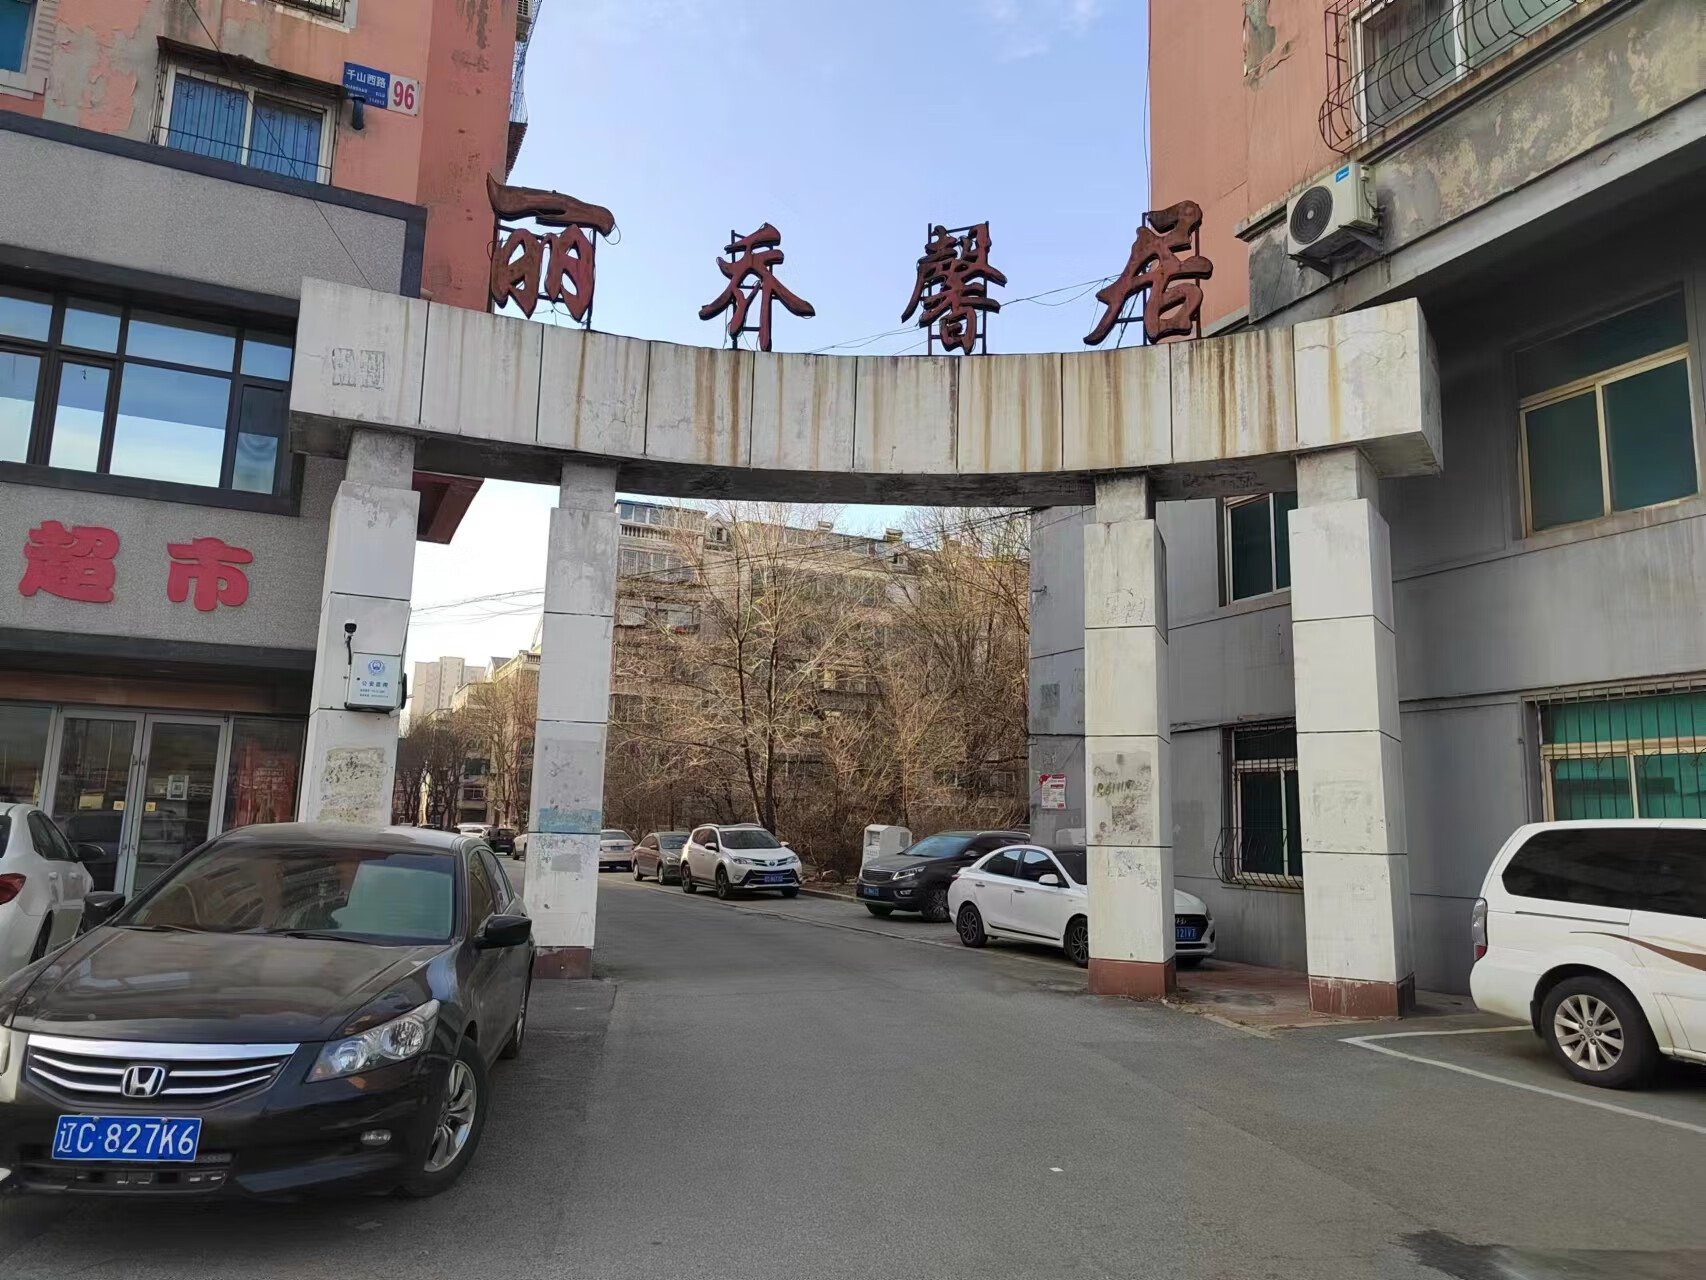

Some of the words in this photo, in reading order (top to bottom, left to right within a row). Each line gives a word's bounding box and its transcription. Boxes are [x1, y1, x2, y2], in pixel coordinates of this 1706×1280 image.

[346, 69, 386, 88] 千山西路
[392, 80, 415, 110] 96
[18, 520, 255, 612] 超市
